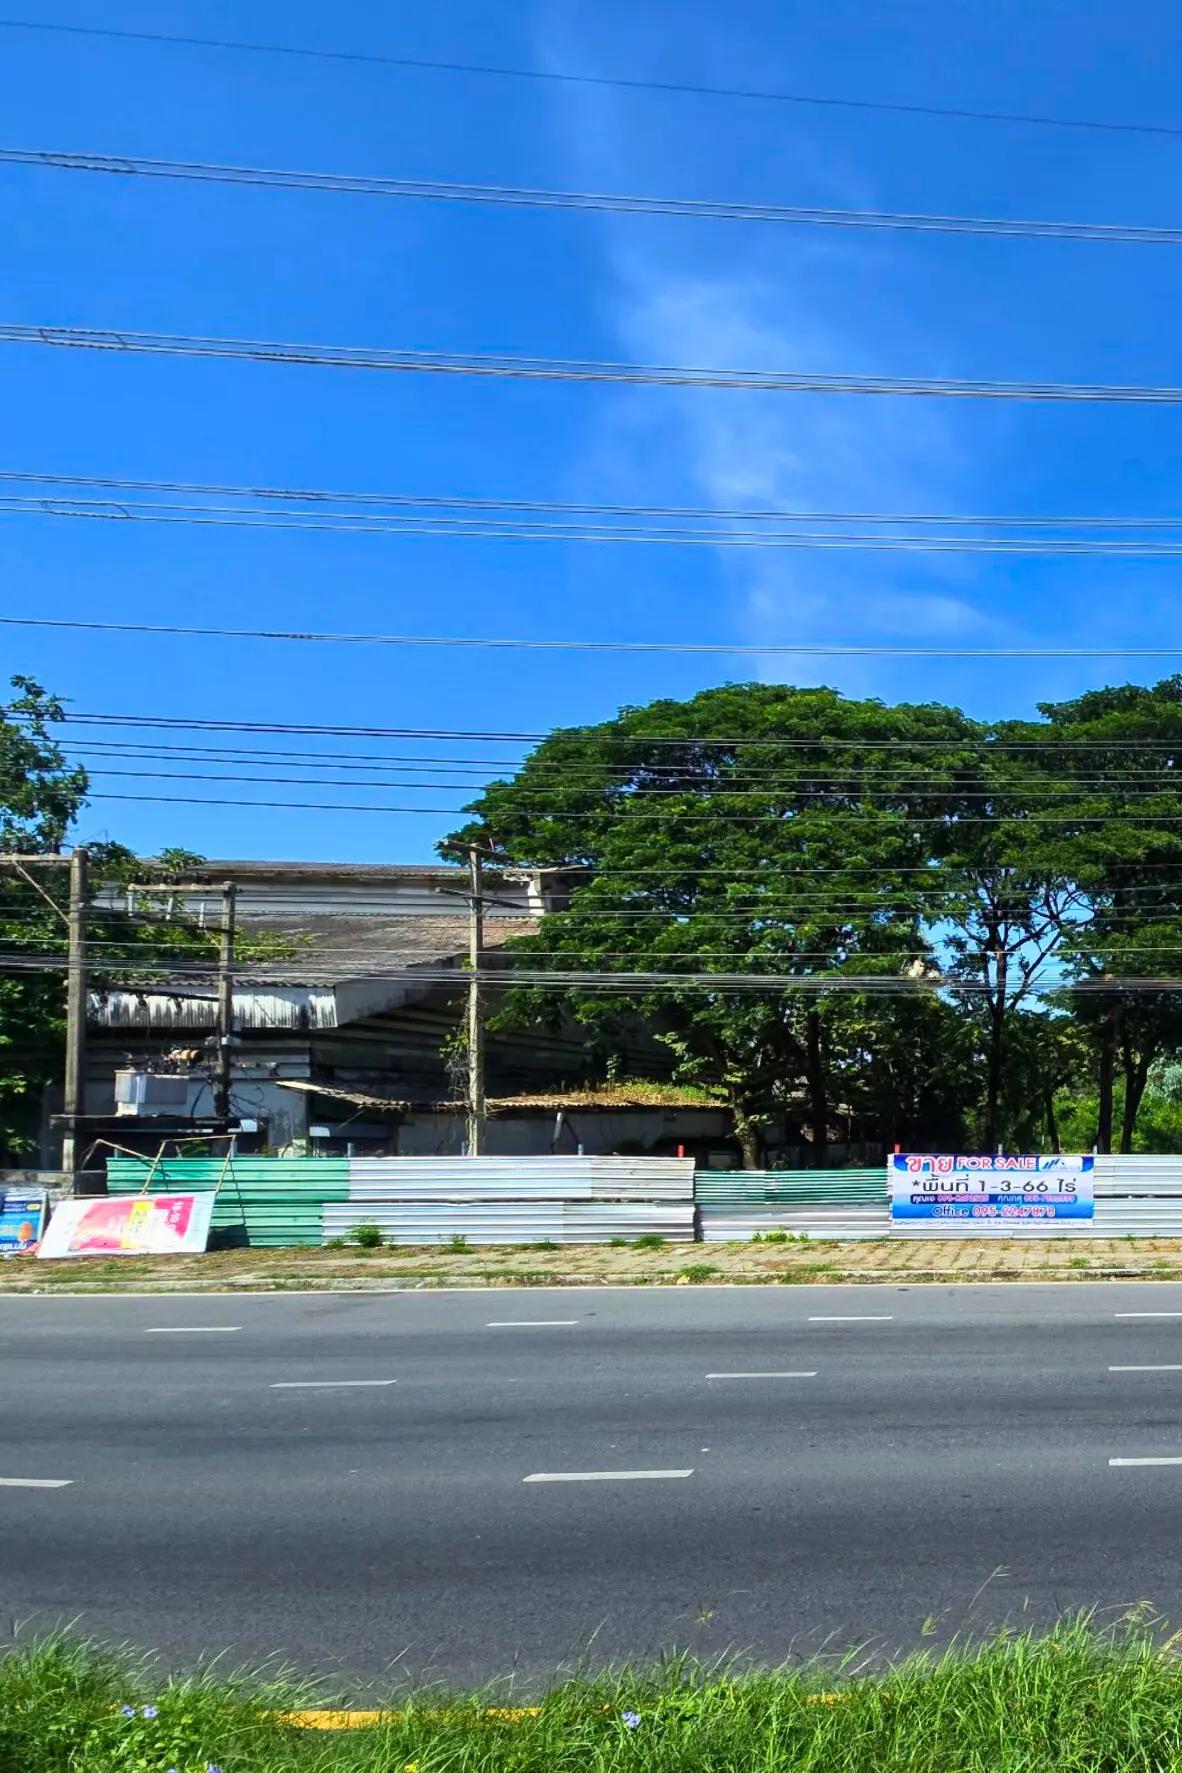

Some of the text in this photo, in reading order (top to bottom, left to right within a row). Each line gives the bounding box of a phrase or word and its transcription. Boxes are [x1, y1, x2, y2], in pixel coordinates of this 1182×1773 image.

[907, 1156, 954, 1174] ขาย
[957, 1156, 992, 1170] FOR
[994, 1156, 1037, 1170] SALE
[979, 1179, 1049, 1193] 1-3-66
[1058, 1177, 1077, 1193] ไร่
[932, 1206, 969, 1217] Office
